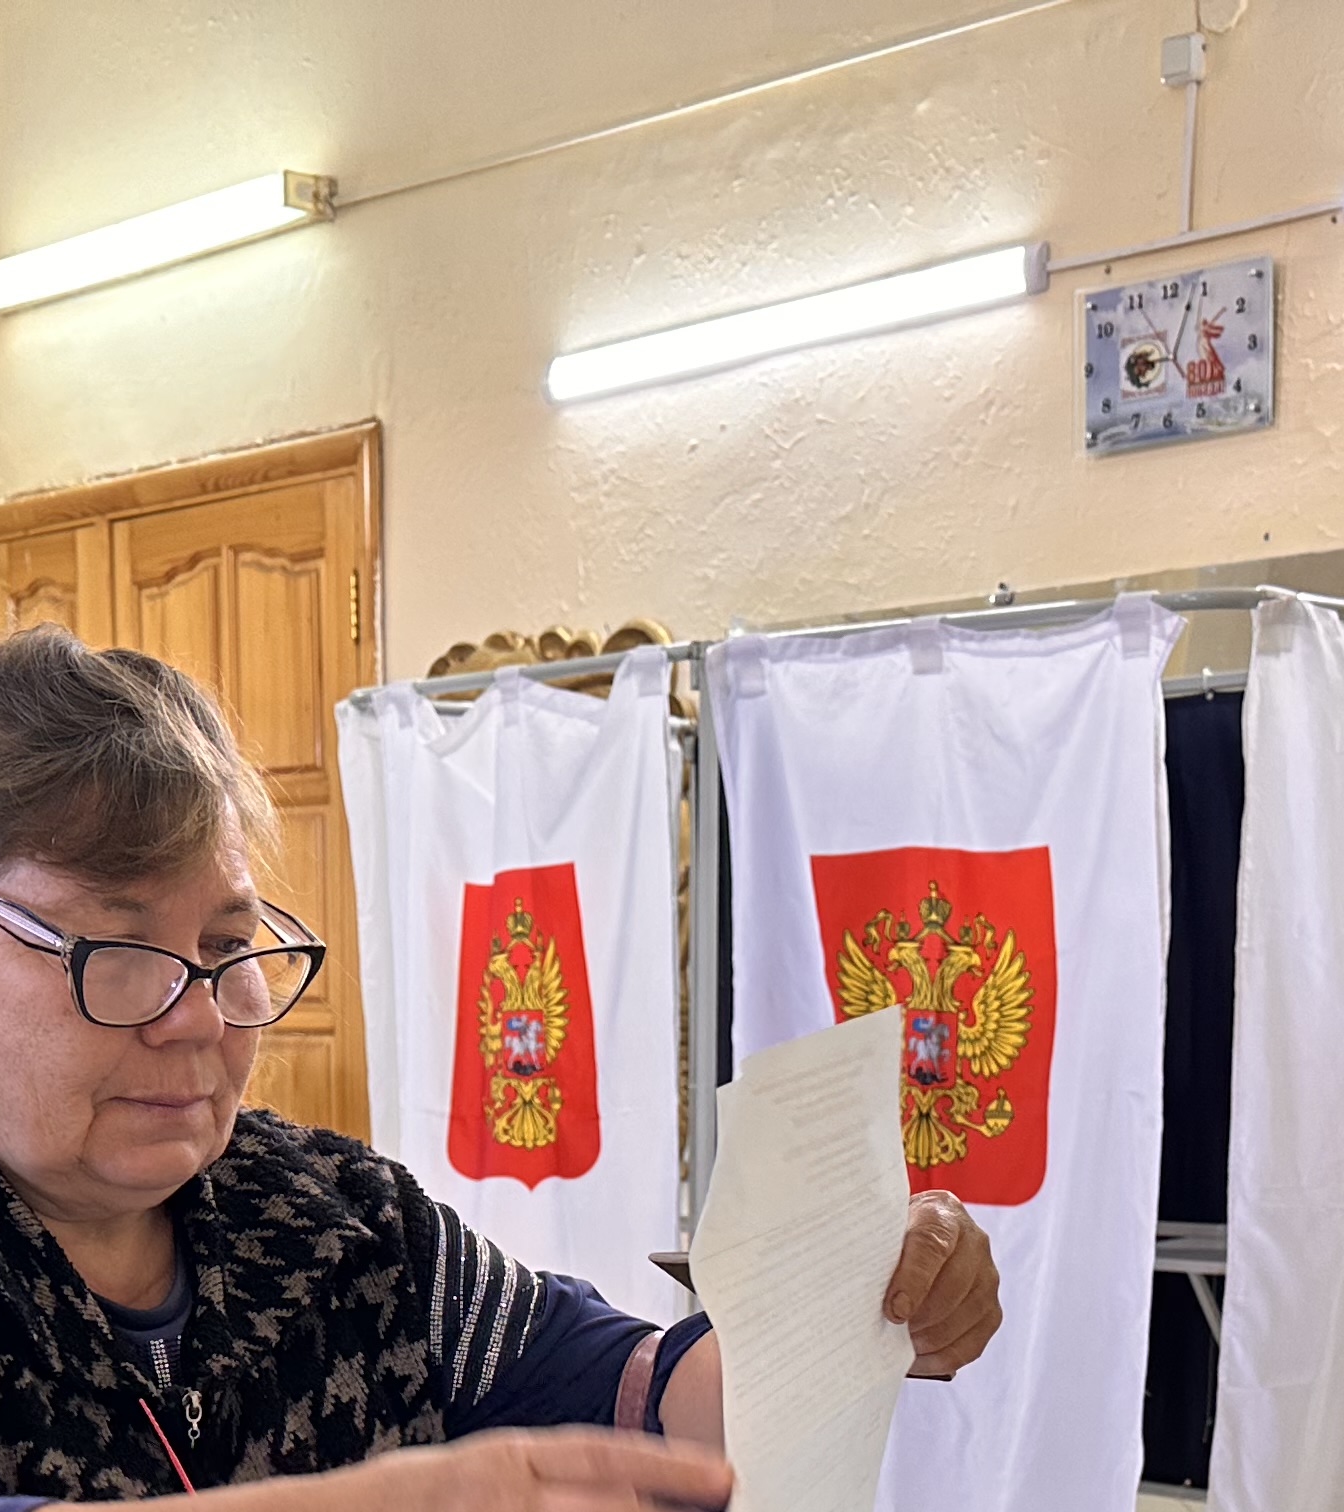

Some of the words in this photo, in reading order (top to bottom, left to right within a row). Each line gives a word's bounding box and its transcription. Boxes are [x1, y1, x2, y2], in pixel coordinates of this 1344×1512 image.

[1161, 283, 1179, 300] 12
[1202, 281, 1207, 297] 1
[1128, 295, 1143, 310] 11
[1235, 298, 1245, 314] 2
[1097, 322, 1114, 339] 10
[1248, 334, 1257, 351] 3
[1085, 361, 1093, 378] 9
[1233, 378, 1242, 393] 4
[1101, 399, 1112, 414] 8
[1196, 402, 1206, 418] 5
[1131, 413, 1140, 429] 7
[1163, 413, 1173, 429] 6
